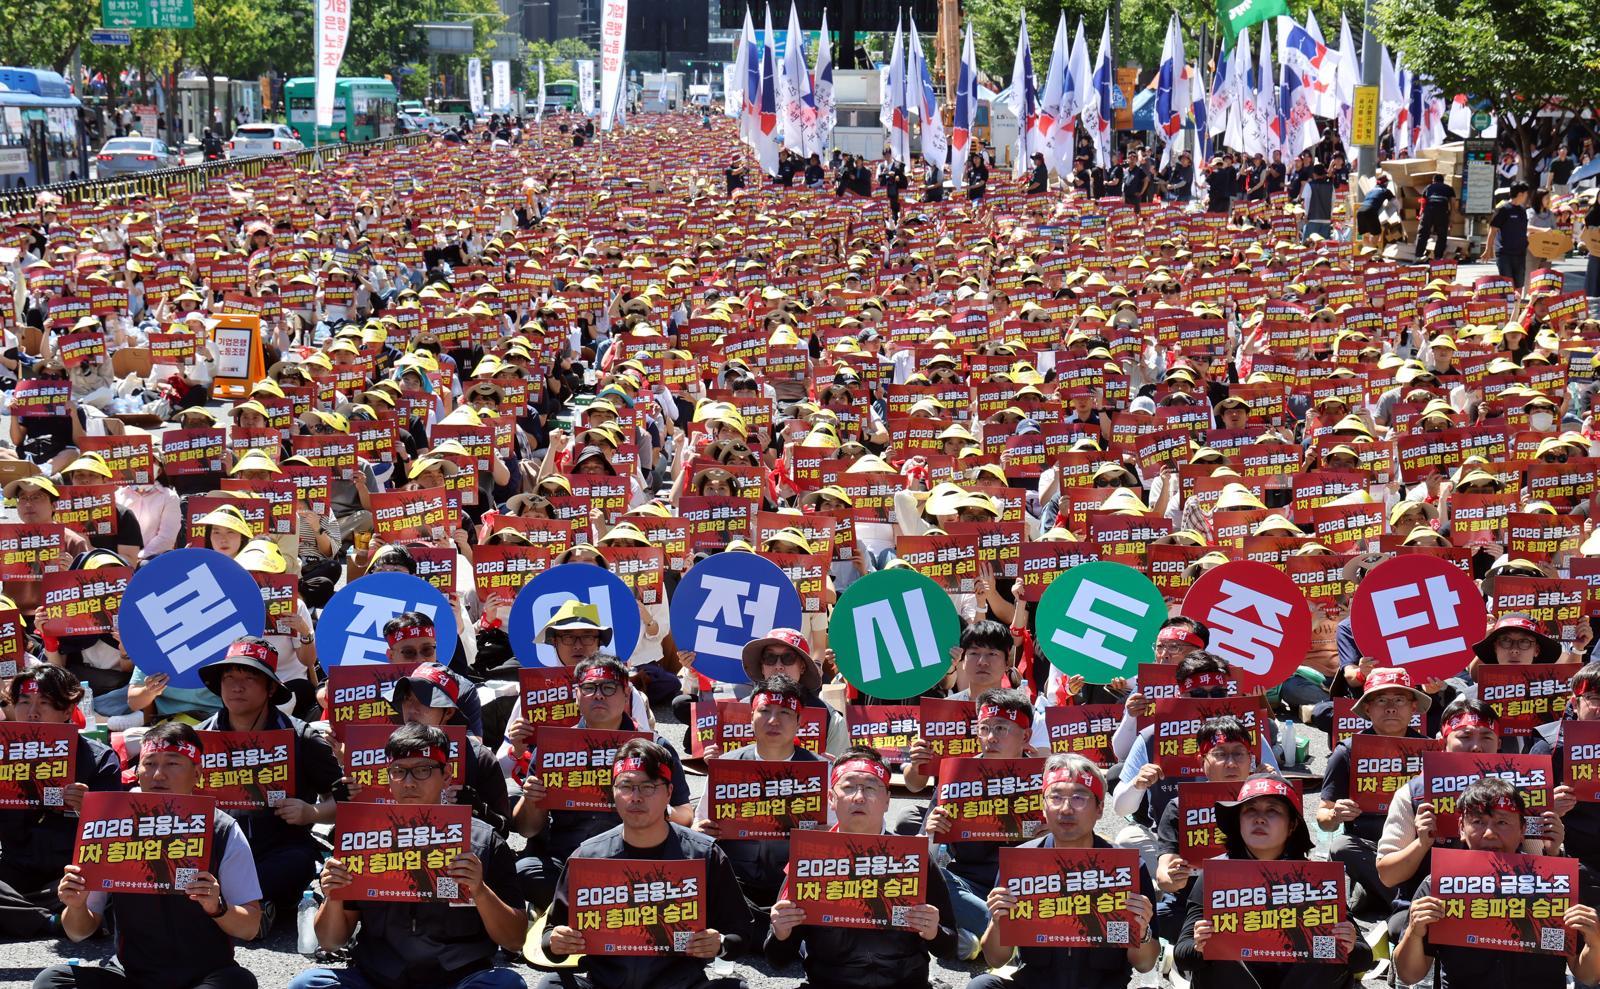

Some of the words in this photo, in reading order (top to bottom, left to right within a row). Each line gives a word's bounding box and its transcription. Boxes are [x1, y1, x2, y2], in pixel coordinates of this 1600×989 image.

[164, 440, 190, 452] 2026
[191, 436, 223, 448] 금융노조
[1402, 446, 1427, 458] 2026
[1429, 441, 1458, 455] 금융노조
[179, 450, 203, 461] 총파업
[204, 447, 223, 457] 승리
[1417, 455, 1442, 468] 총파업
[1444, 452, 1460, 464] 승리
[1531, 477, 1559, 489] 2026
[1561, 472, 1594, 485] 금융노조
[1547, 486, 1572, 498] 총파업
[1574, 484, 1594, 496] 승리
[376, 509, 403, 520] 2026
[405, 497, 443, 515] 금융노조
[712, 507, 746, 519] 금융노조
[377, 520, 391, 533] 1차
[392, 515, 422, 532] 총파업
[424, 511, 445, 525] 승리
[697, 520, 725, 533] 총파업
[726, 518, 747, 531] 승리
[1318, 520, 1345, 533] 2026
[1346, 514, 1382, 529] 금융노조
[1097, 529, 1128, 543] 2026
[1131, 527, 1168, 541] 금융노조
[1333, 529, 1362, 544] 총파업
[1364, 525, 1382, 539] 승리
[1512, 527, 1540, 539] 2026
[1543, 525, 1581, 538] 금융노조
[938, 547, 976, 561] 금융노조
[1115, 542, 1146, 555] 총파업
[1512, 541, 1525, 551] 1차
[1527, 539, 1557, 552] 총파업
[1559, 537, 1580, 550] 승리
[476, 562, 504, 574] 2026
[507, 557, 546, 571] 금융노조
[921, 562, 952, 577] 총파업
[953, 560, 976, 574] 승리
[45, 585, 80, 603] 2026
[82, 578, 128, 597] 금융노조
[477, 576, 488, 589] 1차
[490, 573, 522, 588] 총파업
[66, 599, 101, 617] 총파업
[694, 574, 780, 660] 전
[135, 562, 248, 675] 본
[340, 591, 438, 665] 점
[1051, 578, 1150, 670] 도
[1207, 579, 1293, 676] 중
[1370, 574, 1467, 666] 단
[852, 587, 941, 683] 시
[334, 685, 376, 704] 2026
[526, 685, 569, 704] 2026
[1484, 685, 1526, 701] 2026
[334, 704, 355, 722] 1차
[527, 706, 548, 724] 1차
[1507, 699, 1548, 717] 총파업
[851, 722, 887, 736] 2026
[925, 721, 966, 736] 2026
[1051, 722, 1087, 737] 2026
[1160, 720, 1200, 737] 2026
[9, 740, 69, 760] 금융노조
[873, 736, 908, 749] 총파업
[1052, 739, 1069, 753] 1차
[1072, 734, 1107, 750] 총파업
[1159, 738, 1179, 756] 1차
[231, 744, 288, 766] 금융노조
[542, 750, 587, 768] 2026
[35, 760, 68, 779] 승리
[1357, 758, 1401, 774] 2026
[1571, 764, 1593, 781] 1차
[209, 768, 254, 788] 총파업
[258, 765, 288, 784] 승리
[542, 771, 563, 789] 1차
[567, 769, 612, 788] 총파업
[1357, 776, 1378, 793] 1차
[715, 781, 761, 800] 2026
[764, 776, 821, 797] 금융노조
[940, 780, 983, 800] 2026
[987, 774, 1043, 795] 금융노조
[715, 802, 736, 820] 1차
[740, 799, 786, 819] 총파업
[791, 796, 821, 814] 승리
[963, 799, 1009, 819] 총파업
[1013, 794, 1043, 814] 승리
[82, 818, 133, 840] 2026
[138, 814, 206, 837] 금융노조
[341, 830, 392, 851] 2026
[396, 823, 463, 848] 금융노조
[78, 844, 103, 864] 1차
[107, 841, 162, 863] 총파업
[167, 837, 205, 859] 승리
[369, 851, 422, 873] 총파업
[797, 858, 850, 877] 2026
[854, 854, 920, 876] 금융노조
[796, 882, 822, 901] 1차
[825, 879, 878, 900] 총파업
[883, 877, 919, 897] 승리
[1007, 874, 1061, 896] 2026
[1065, 866, 1132, 892] 금융노조
[1439, 875, 1496, 894] 2026
[1500, 874, 1570, 894] 금융노조
[576, 885, 629, 907] 2026
[632, 877, 699, 902] 금융노조
[1211, 886, 1267, 909] 2026
[1271, 880, 1338, 903] 금융노조
[576, 910, 602, 931] 1차
[605, 906, 658, 930] 총파업
[663, 900, 699, 921] 승리
[1037, 894, 1091, 918] 총파업
[1470, 898, 1525, 919] 총파업
[1531, 897, 1570, 918] 승리
[1212, 912, 1238, 933] 1차
[1243, 908, 1297, 931] 총파업
[1302, 903, 1339, 924] 승리
